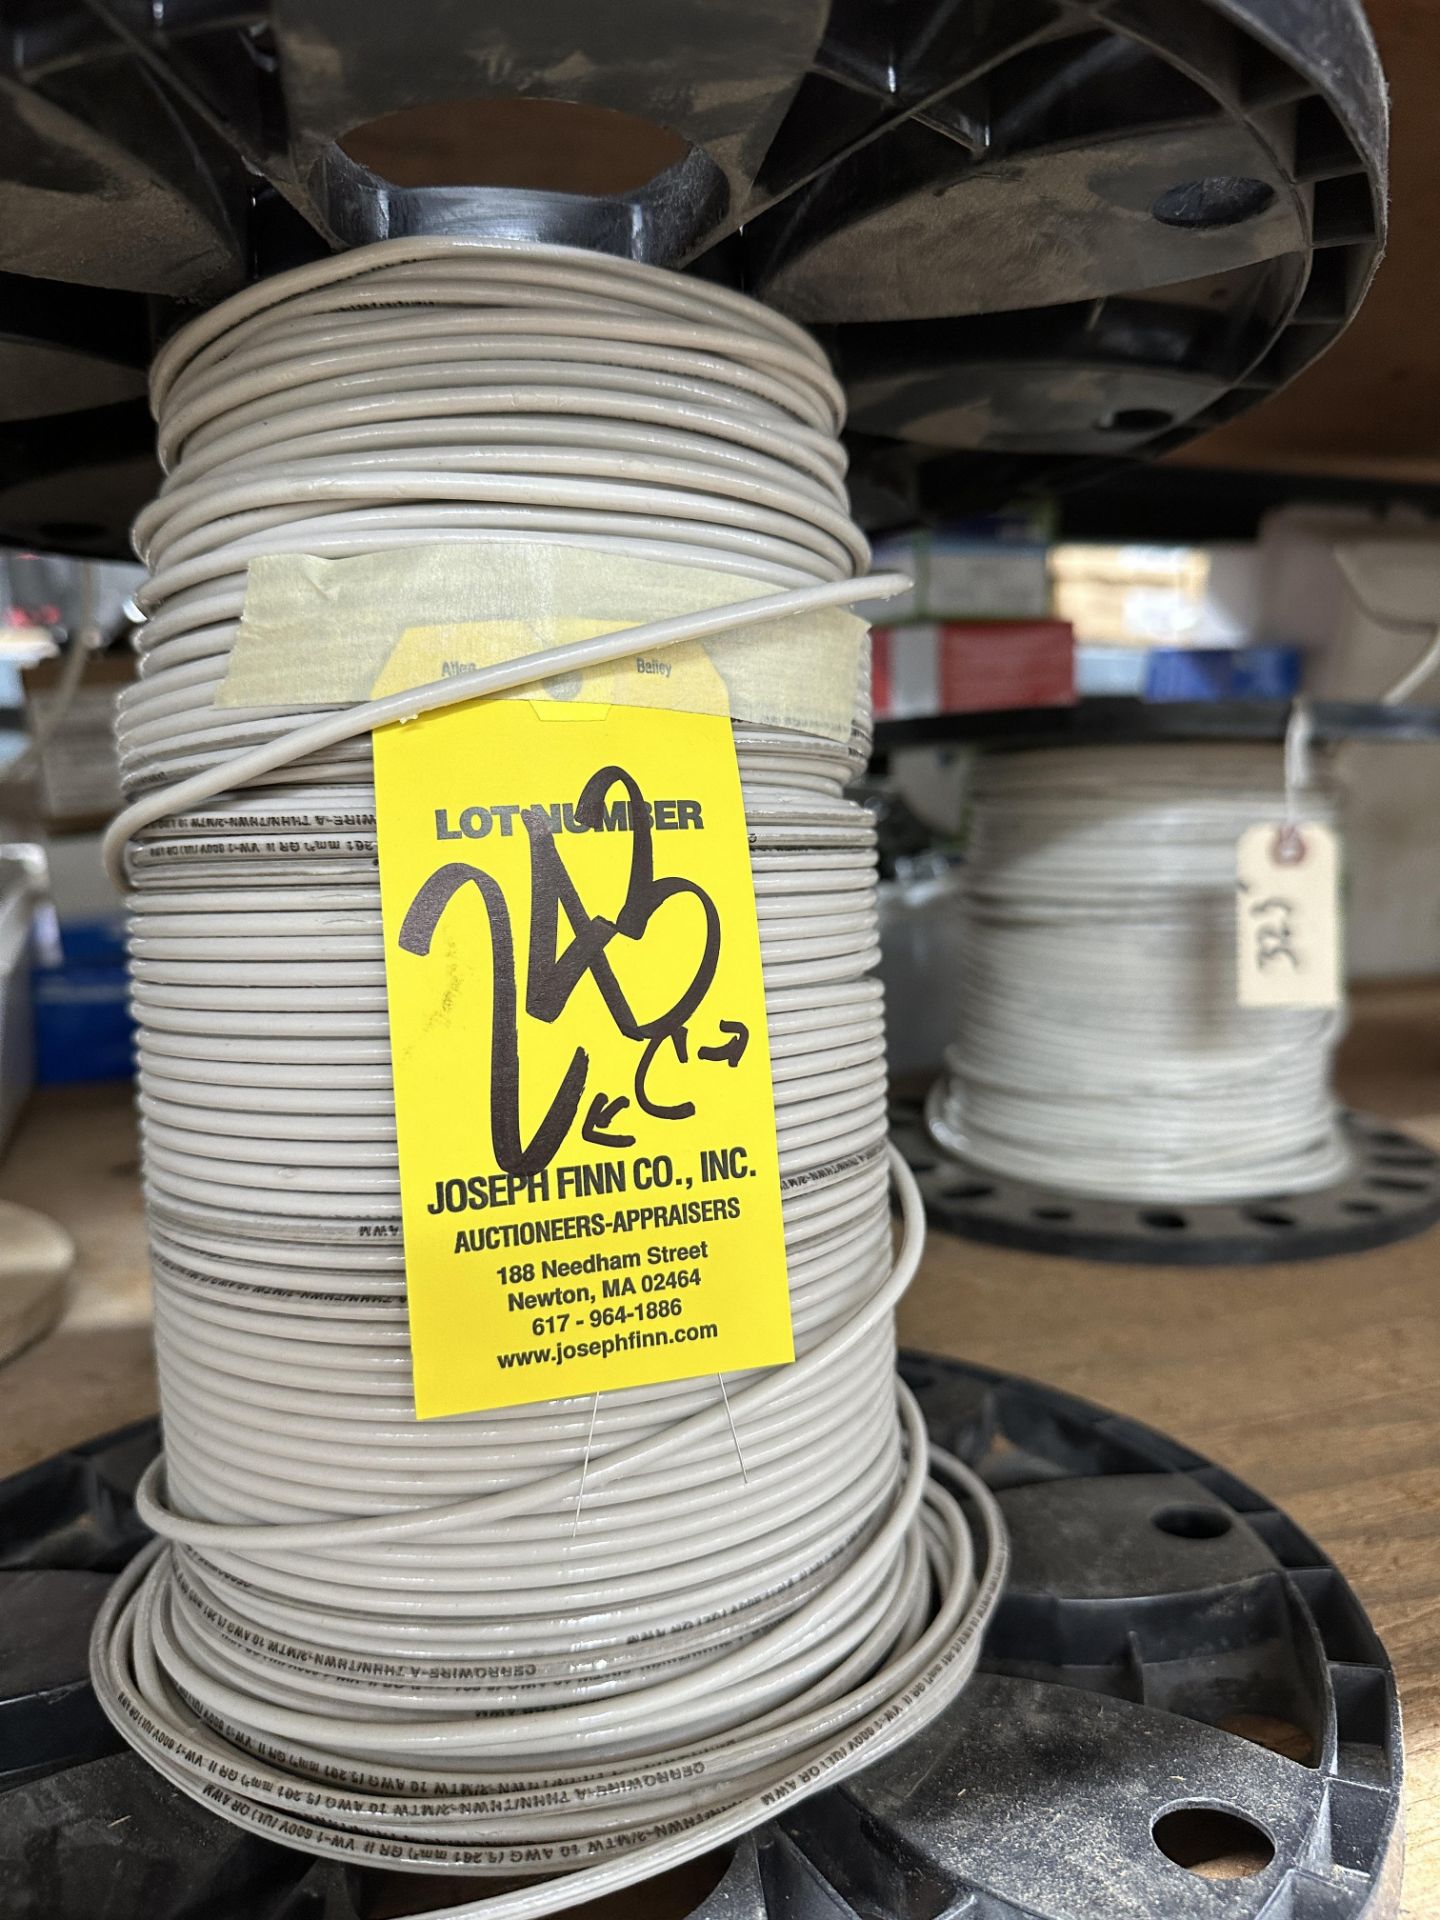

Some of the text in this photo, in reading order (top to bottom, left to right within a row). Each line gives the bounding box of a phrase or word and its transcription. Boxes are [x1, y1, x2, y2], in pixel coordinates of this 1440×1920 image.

[434, 800, 705, 840] LOT NUMBER
[427, 1147, 757, 1215] JOSEPH FINN CO., INC.
[454, 1198, 741, 1254] AUCTIONEERS-APPRAISERS
[497, 1241, 709, 1286] 188 Needham Street
[508, 1268, 702, 1312] Newton, MA 02464
[532, 1312, 569, 1336] 617
[589, 1298, 683, 1328] 964-1886
[497, 1321, 719, 1370] www.josephfinn.com
[760, 1779, 797, 1806] AWM
[279, 1820, 314, 1840] 600V
[316, 1831, 355, 1850] VW-1
[380, 1843, 403, 1859] GR
[510, 1848, 553, 1863] AWG
